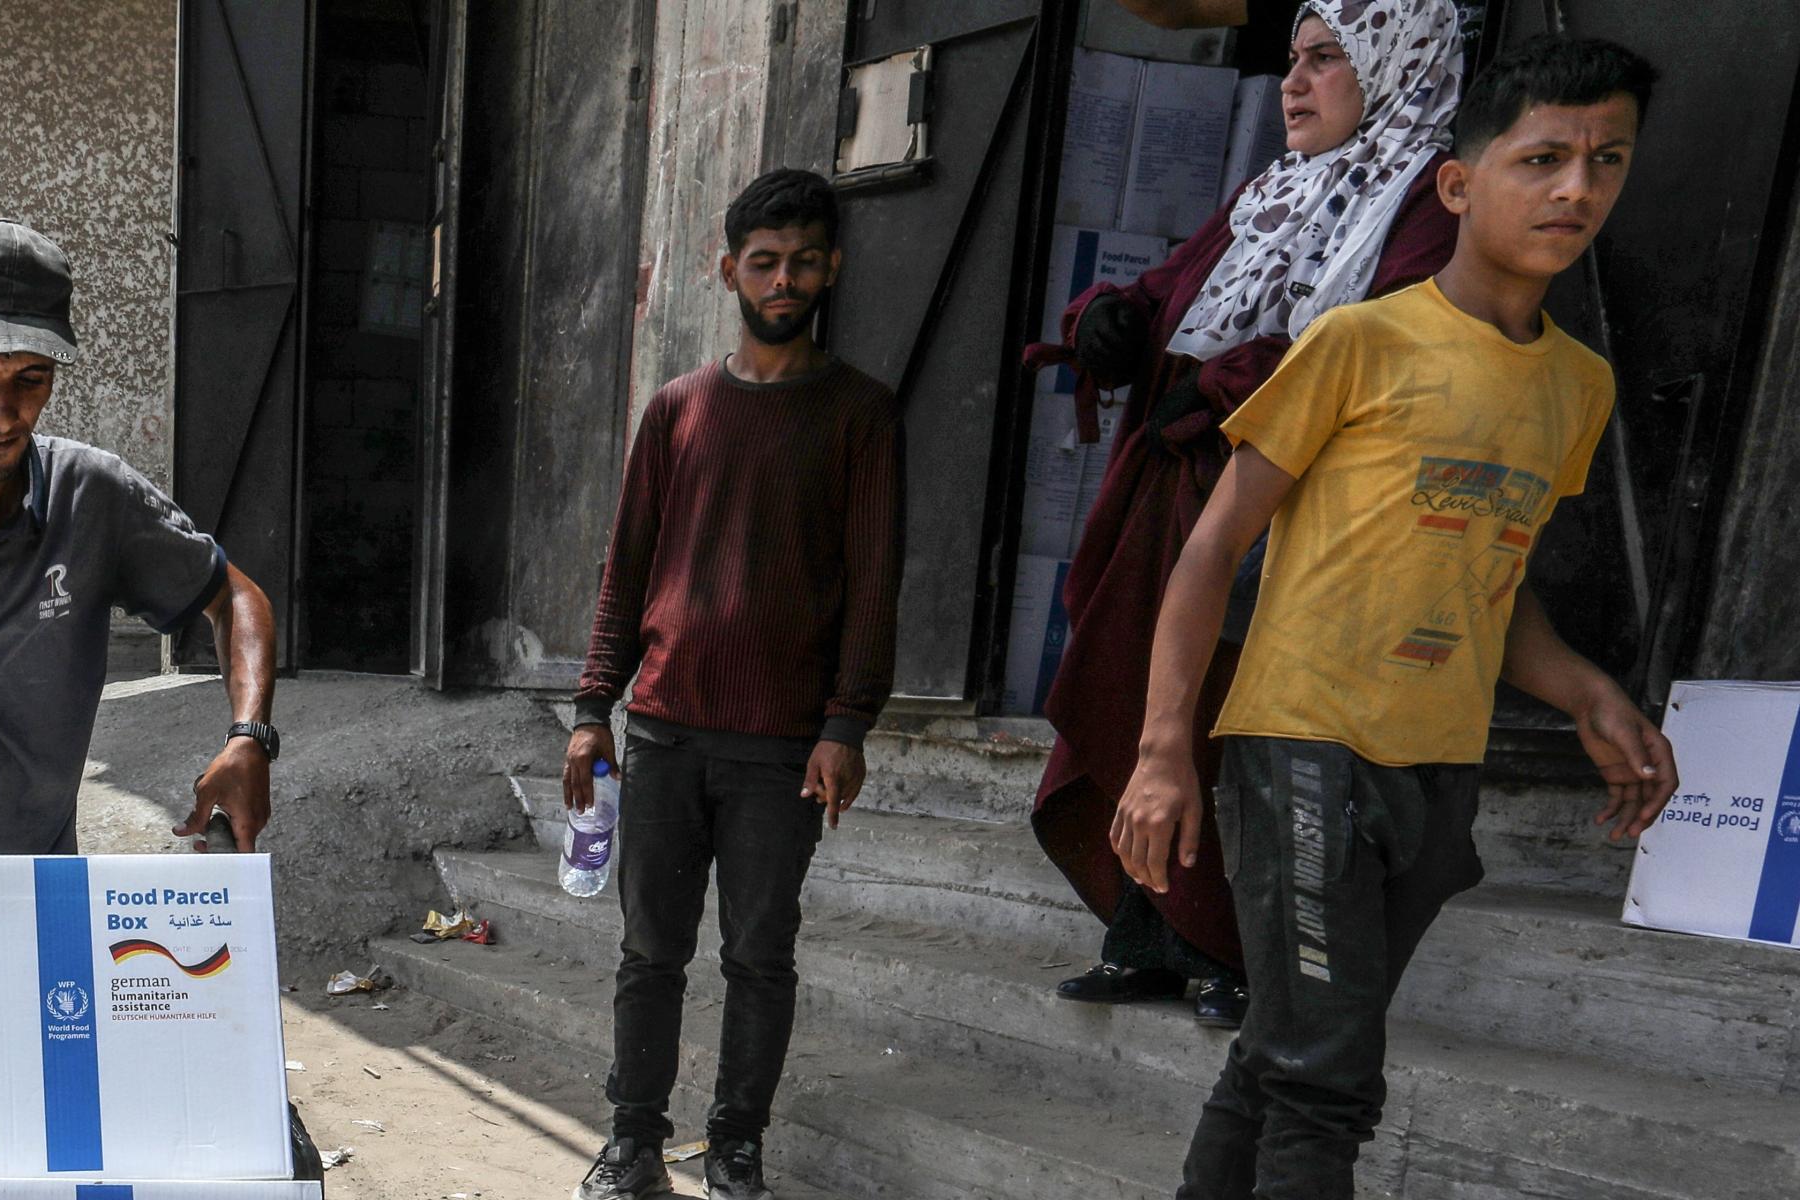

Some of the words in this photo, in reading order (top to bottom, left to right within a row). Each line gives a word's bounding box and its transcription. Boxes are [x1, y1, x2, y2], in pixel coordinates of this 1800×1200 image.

[1102, 251, 1123, 261] Food
[1124, 253, 1150, 265] Parcel
[1731, 795, 1764, 812] Box
[1661, 809, 1713, 826] Parcel
[1716, 814, 1760, 831] Food
[1292, 796, 1325, 896] FASHION
[106, 888, 157, 905] Food
[163, 888, 229, 904] Parcel
[107, 914, 148, 930] Box
[209, 914, 232, 927] سلة
[1295, 894, 1328, 946] BOY
[111, 977, 171, 991] german
[111, 991, 188, 1001] humanitarian
[112, 1002, 170, 1012] assistance
[150, 1012, 195, 1020] HUMANITÄRE
[48, 1033, 90, 1041] Programme
